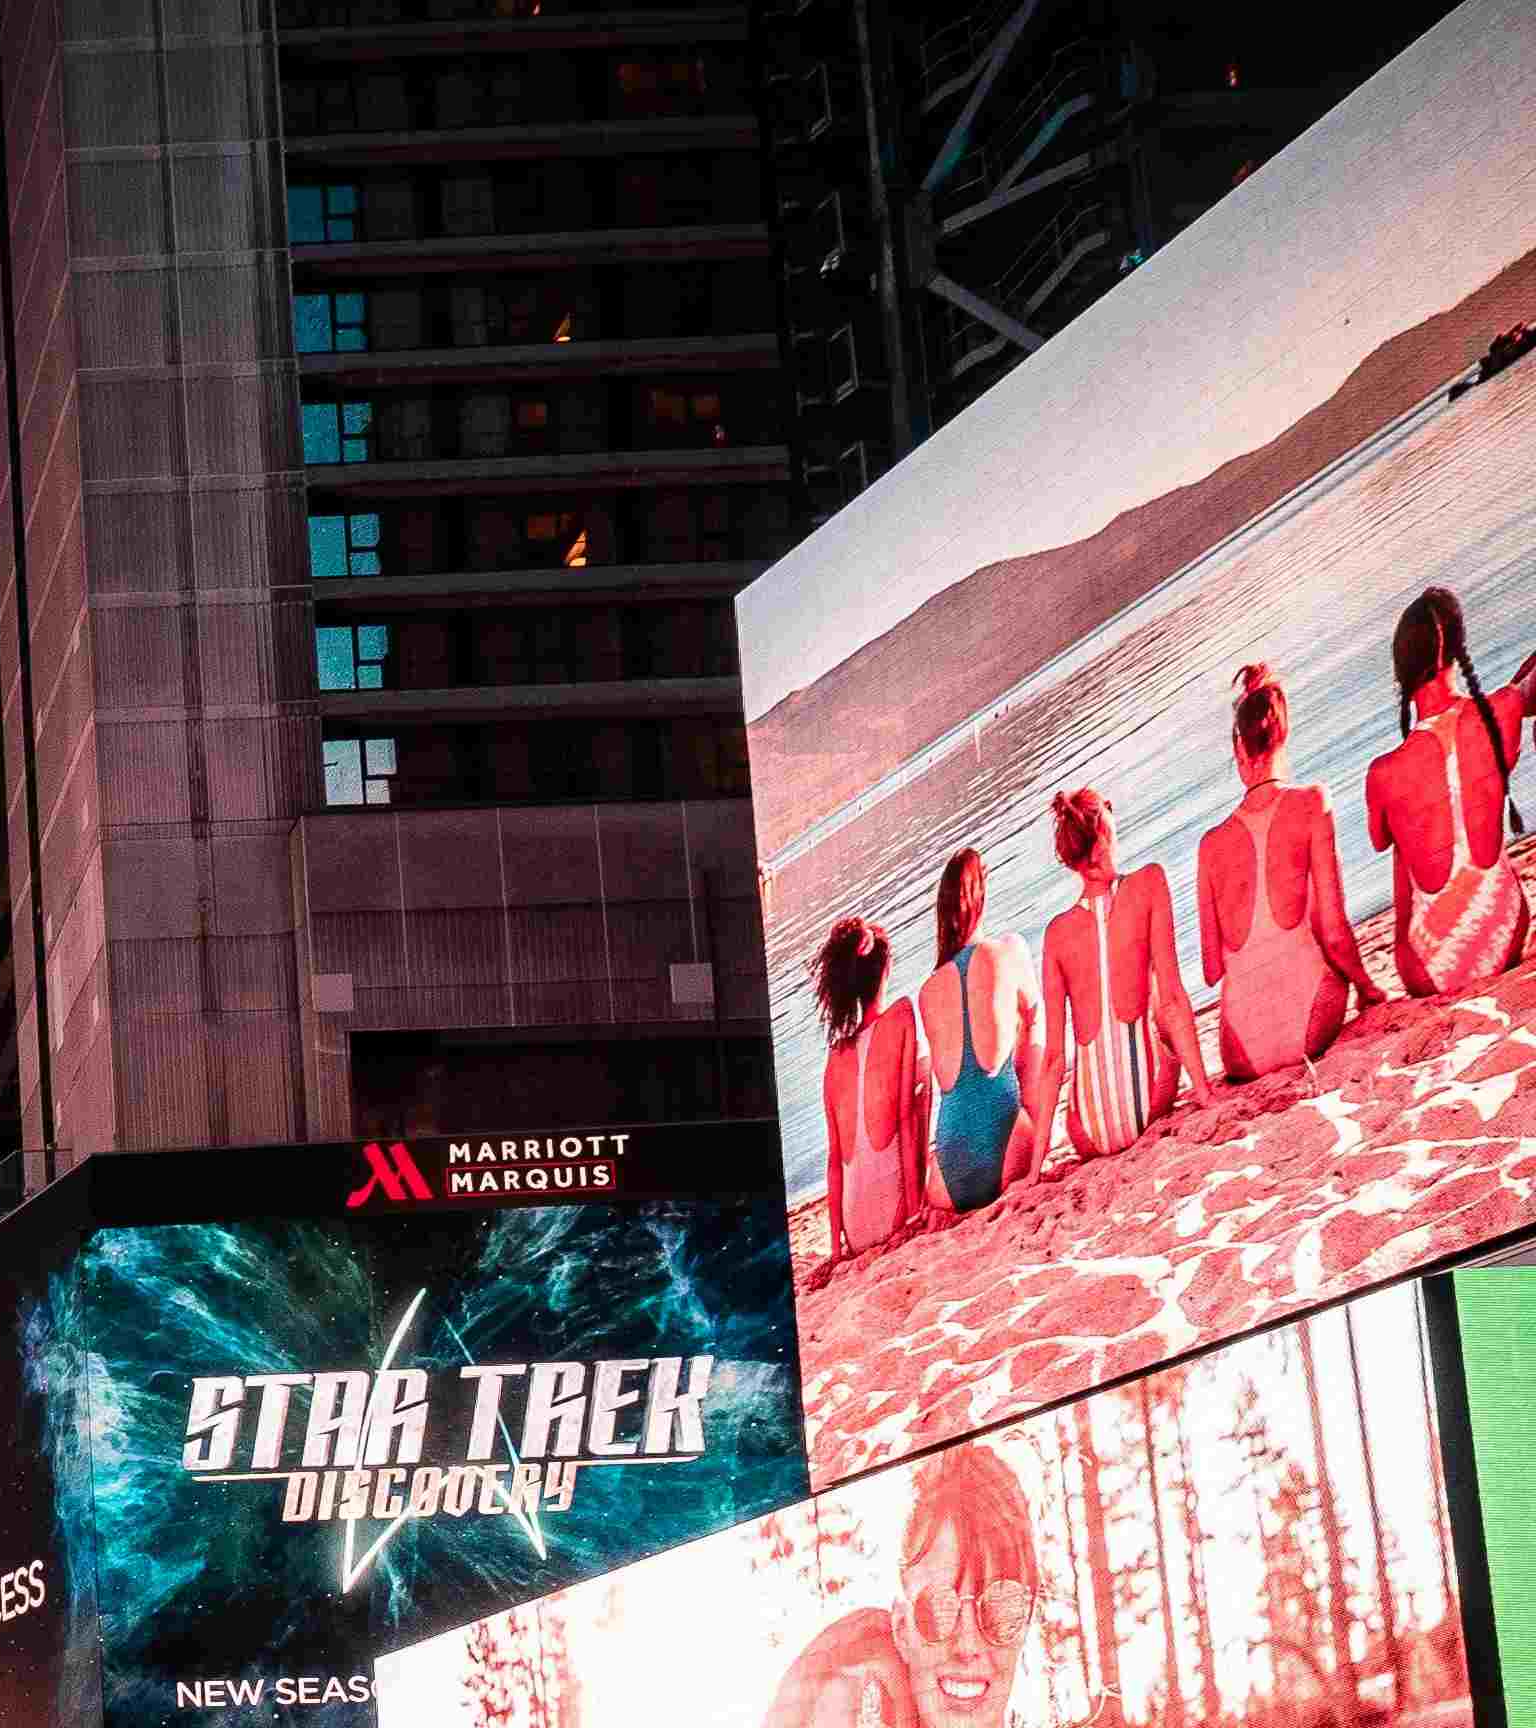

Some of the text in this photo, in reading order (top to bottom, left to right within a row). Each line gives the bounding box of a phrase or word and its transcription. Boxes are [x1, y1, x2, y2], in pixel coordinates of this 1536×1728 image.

[448, 1133, 630, 1164] MARRIOTT
[450, 1163, 612, 1193] MARQUIS
[183, 1354, 714, 1471] STAR TREK
[281, 1461, 578, 1522] DISCOVERY
[177, 1675, 379, 1709] NEW SEAS
